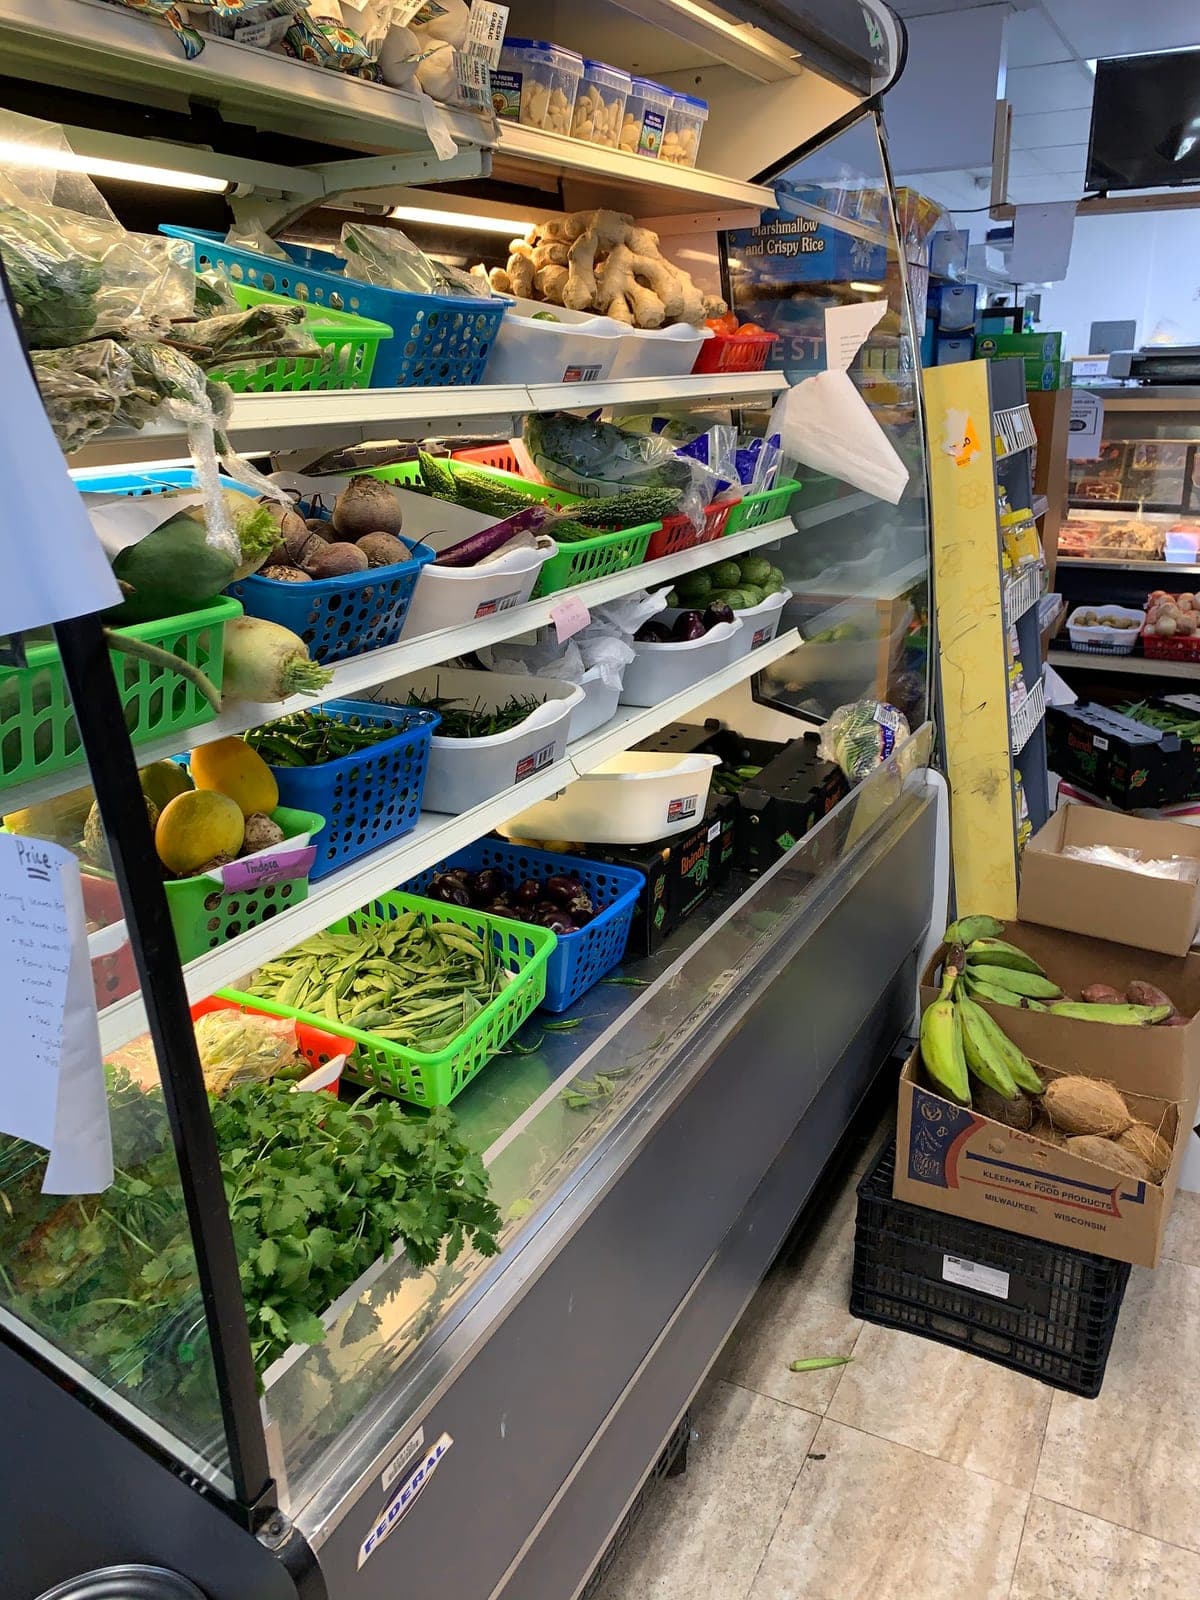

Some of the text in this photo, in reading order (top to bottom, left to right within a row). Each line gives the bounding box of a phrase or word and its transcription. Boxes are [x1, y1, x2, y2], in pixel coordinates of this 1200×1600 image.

[487, 11, 498, 41] GARLIC
[495, 15, 504, 41] FRESH
[751, 217, 818, 237] Marshmallow
[745, 236, 825, 257] and Crispy Rice
[241, 859, 280, 875] Tindora
[982, 1169, 1112, 1211] KLEEN-PAK FOOD PRODUCTS
[1054, 1211, 1108, 1232] WISCONSIN
[364, 1445, 447, 1555] FEDERAL
